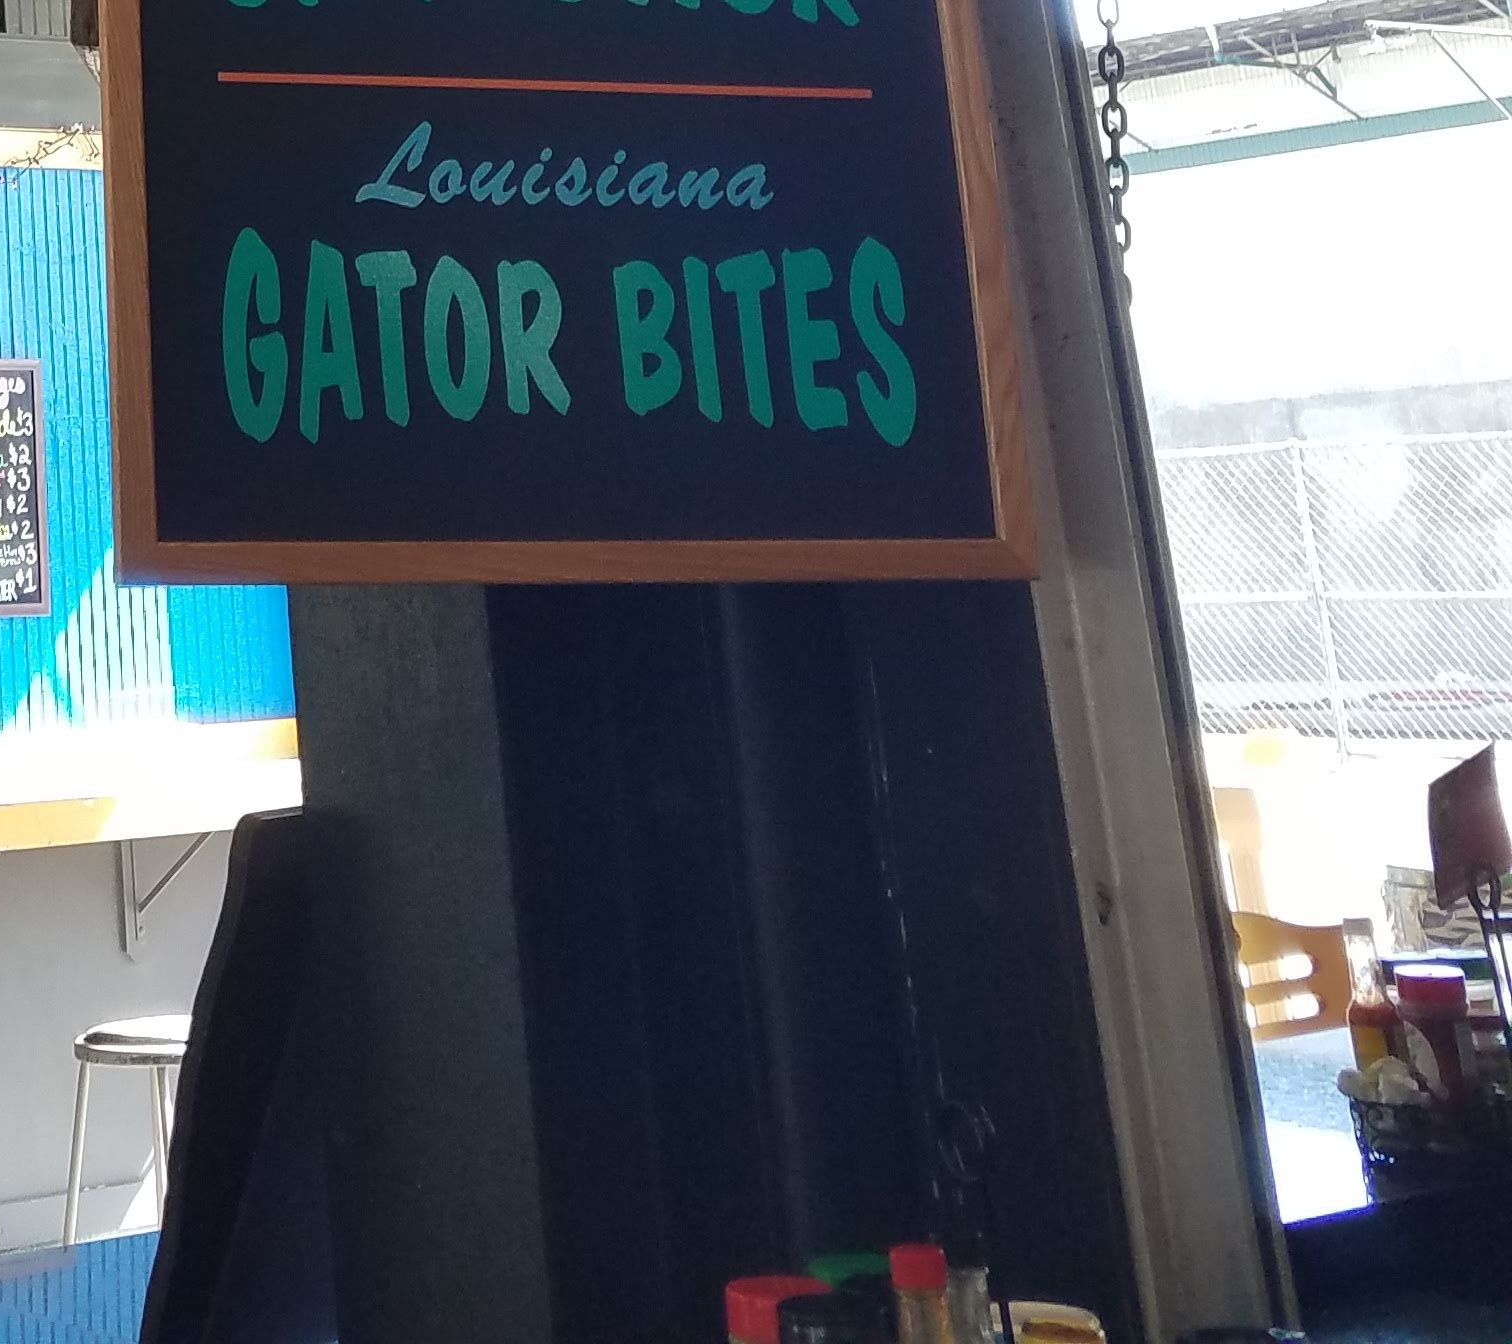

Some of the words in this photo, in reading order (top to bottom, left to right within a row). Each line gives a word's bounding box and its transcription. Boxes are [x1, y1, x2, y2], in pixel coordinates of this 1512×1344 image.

[355, 120, 774, 210] Louisiana
[222, 227, 572, 444] GATOR
[613, 236, 918, 447] BITES
[9, 442, 32, 466] $2
[7, 467, 30, 491] $3
[6, 494, 29, 515] $2
[15, 567, 37, 594] $1
